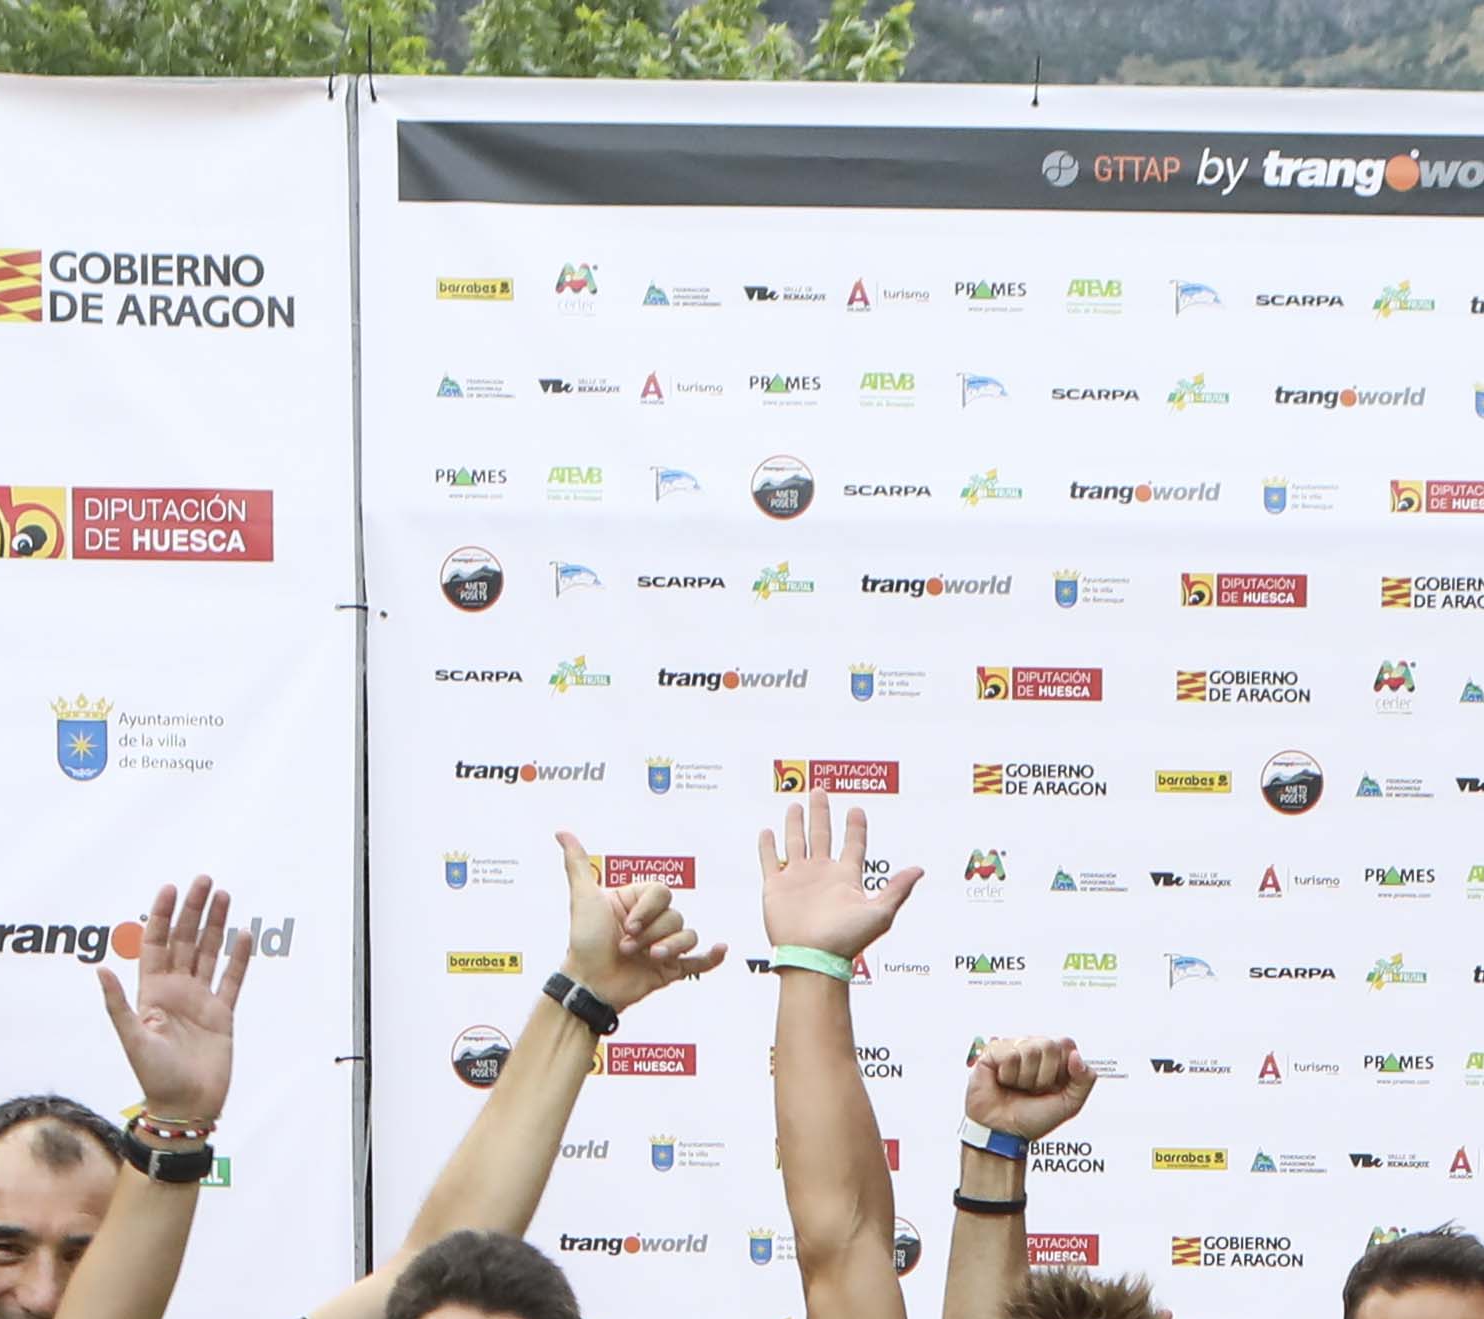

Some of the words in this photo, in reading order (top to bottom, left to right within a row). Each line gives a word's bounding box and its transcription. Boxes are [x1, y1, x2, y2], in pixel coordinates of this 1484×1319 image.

[1094, 156, 1180, 182] GTTAP
[1197, 148, 1248, 195] by
[50, 251, 264, 287] GOBIERNO
[440, 281, 497, 294] barrabes
[884, 290, 929, 301] turismo
[1257, 295, 1344, 306] SCARPA
[50, 291, 103, 324] DE
[117, 294, 294, 328] ARAGON
[1275, 386, 1425, 409] trangoworld
[844, 485, 931, 496] SCARPA
[84, 494, 245, 521] DIPUTACIÓN
[85, 528, 120, 550] DE
[133, 528, 245, 552] HUESCA
[638, 577, 725, 588] SCARPA
[862, 575, 1011, 597] trangoworld
[1222, 577, 1295, 590] DIPUTACIÓN
[1222, 592, 1238, 603] DE
[1243, 592, 1294, 604] HUESCA
[1210, 671, 1298, 685] GOBIERNO
[1209, 688, 1231, 701] DE
[1237, 688, 1310, 702] ARAGON
[119, 712, 224, 728] Ayuntamiento
[119, 734, 137, 746] de
[142, 734, 153, 746] la
[158, 734, 186, 747] villa
[119, 756, 136, 768] de
[142, 756, 213, 772] Benasque
[456, 761, 604, 784] trangoworld
[1159, 775, 1214, 786] barrabes
[450, 956, 505, 967] barrabes
[612, 1046, 684, 1059] DIPUTACIÓN
[612, 1060, 628, 1072] DE
[634, 1061, 684, 1072] HUESCA
[560, 1234, 707, 1256] trangoworld
[1204, 1237, 1291, 1250] GOBIERNO
[1204, 1253, 1225, 1266] DE
[1231, 1253, 1303, 1267] ARAGON
